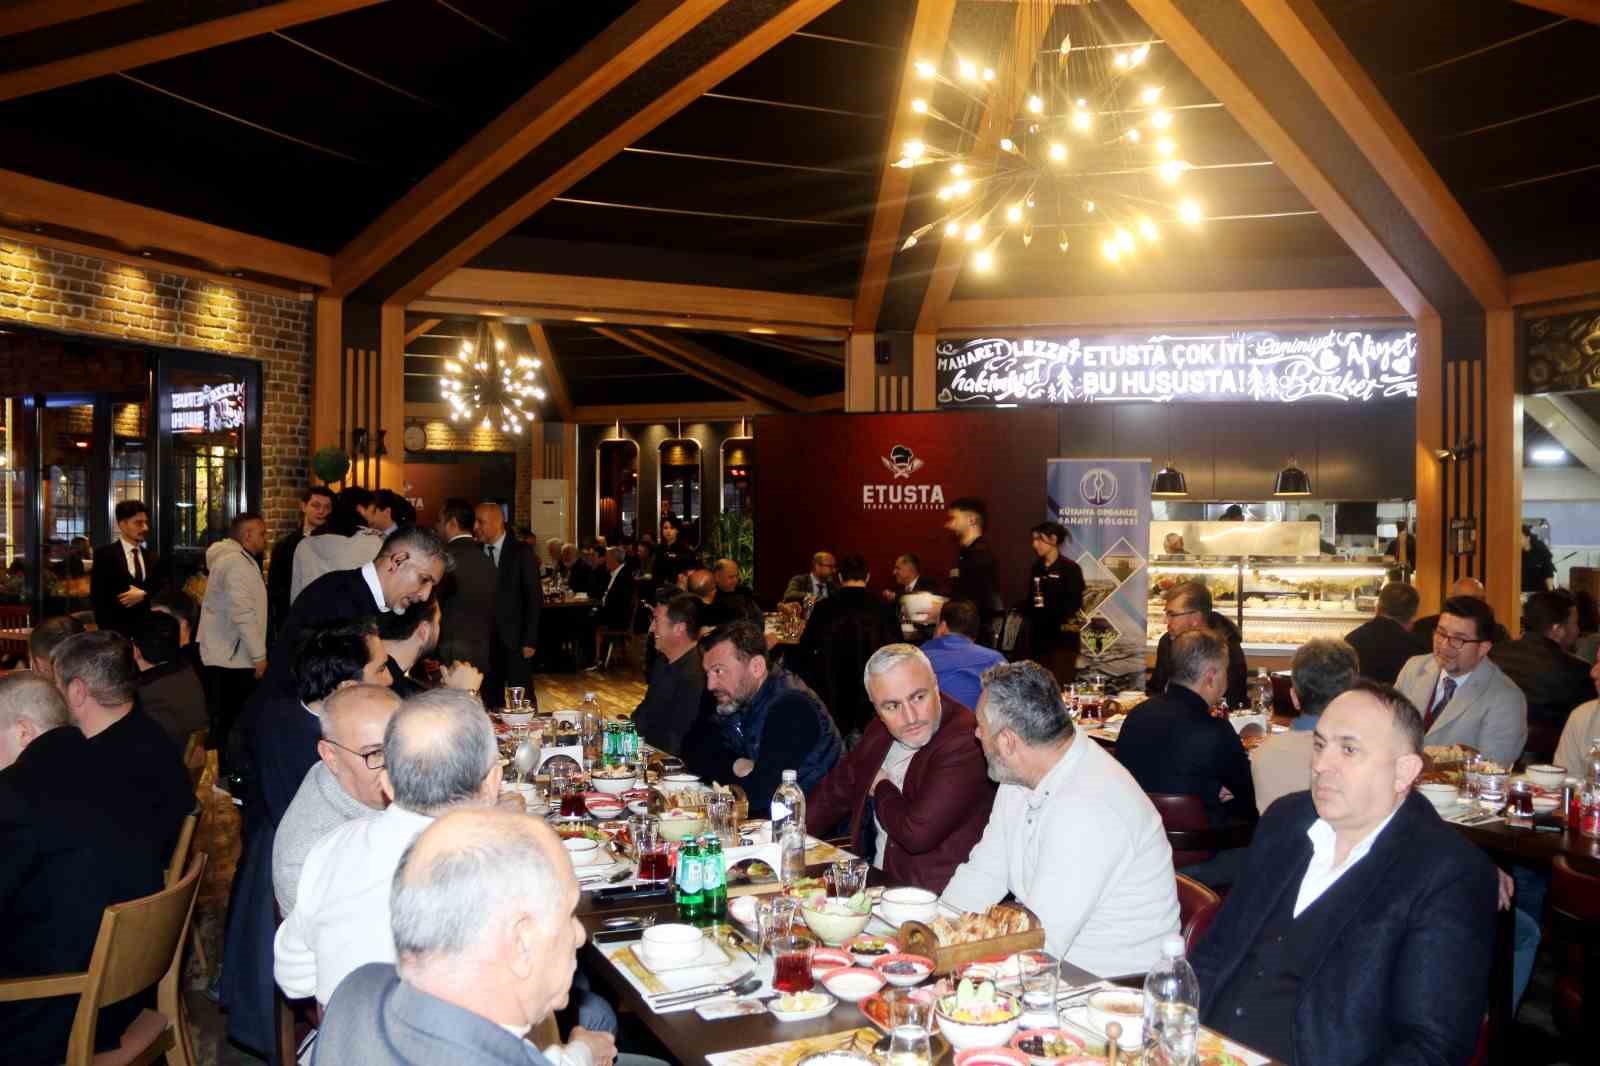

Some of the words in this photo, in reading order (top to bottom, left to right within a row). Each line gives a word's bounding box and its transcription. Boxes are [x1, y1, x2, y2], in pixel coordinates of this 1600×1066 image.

[937, 342, 1004, 371] MAHARET
[1083, 345, 1168, 367] ETUSTA
[1172, 344, 1215, 369] ÇOK
[1219, 338, 1245, 365] İYİ
[1083, 371, 1117, 395] BU
[1122, 369, 1245, 394] HUSUSTA!
[1280, 361, 1383, 401] Bereket
[863, 484, 945, 504] ETUSTA
